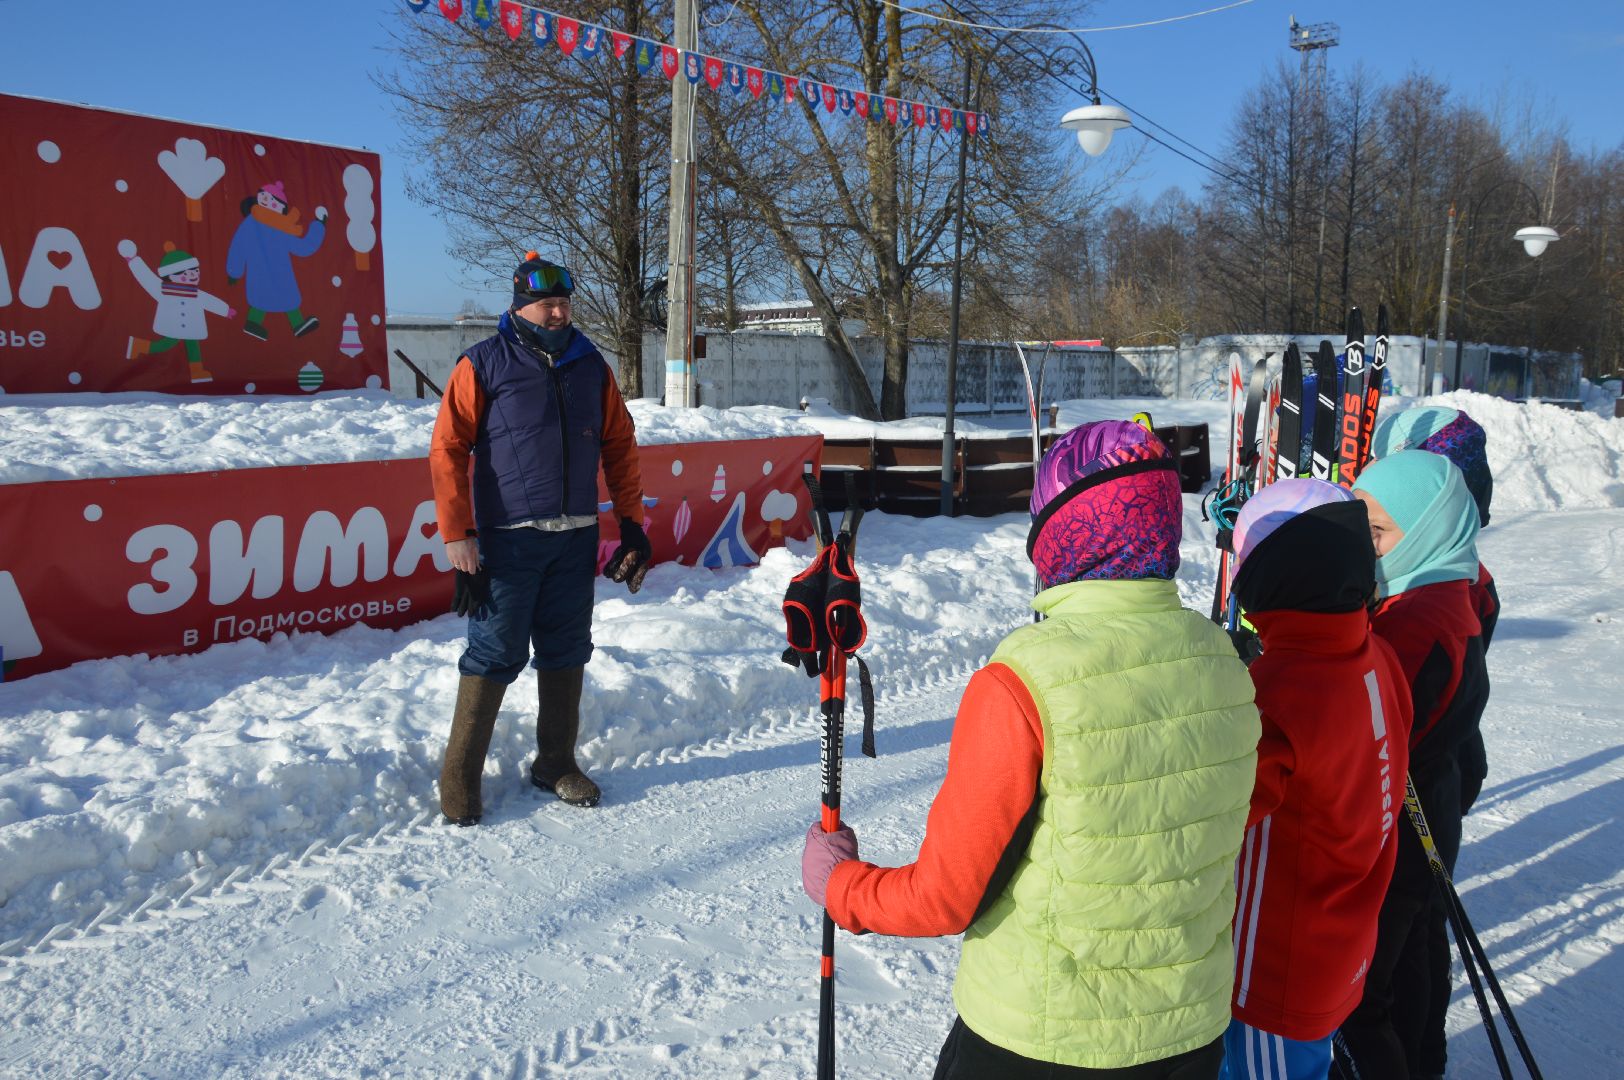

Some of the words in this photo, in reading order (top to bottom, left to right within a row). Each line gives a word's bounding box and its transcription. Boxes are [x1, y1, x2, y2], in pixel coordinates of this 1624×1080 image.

[125, 499, 455, 615] ЗИМА
[183, 629, 199, 646] в
[213, 597, 412, 641] Подмосковье
[820, 712, 830, 794] MADSHUS
